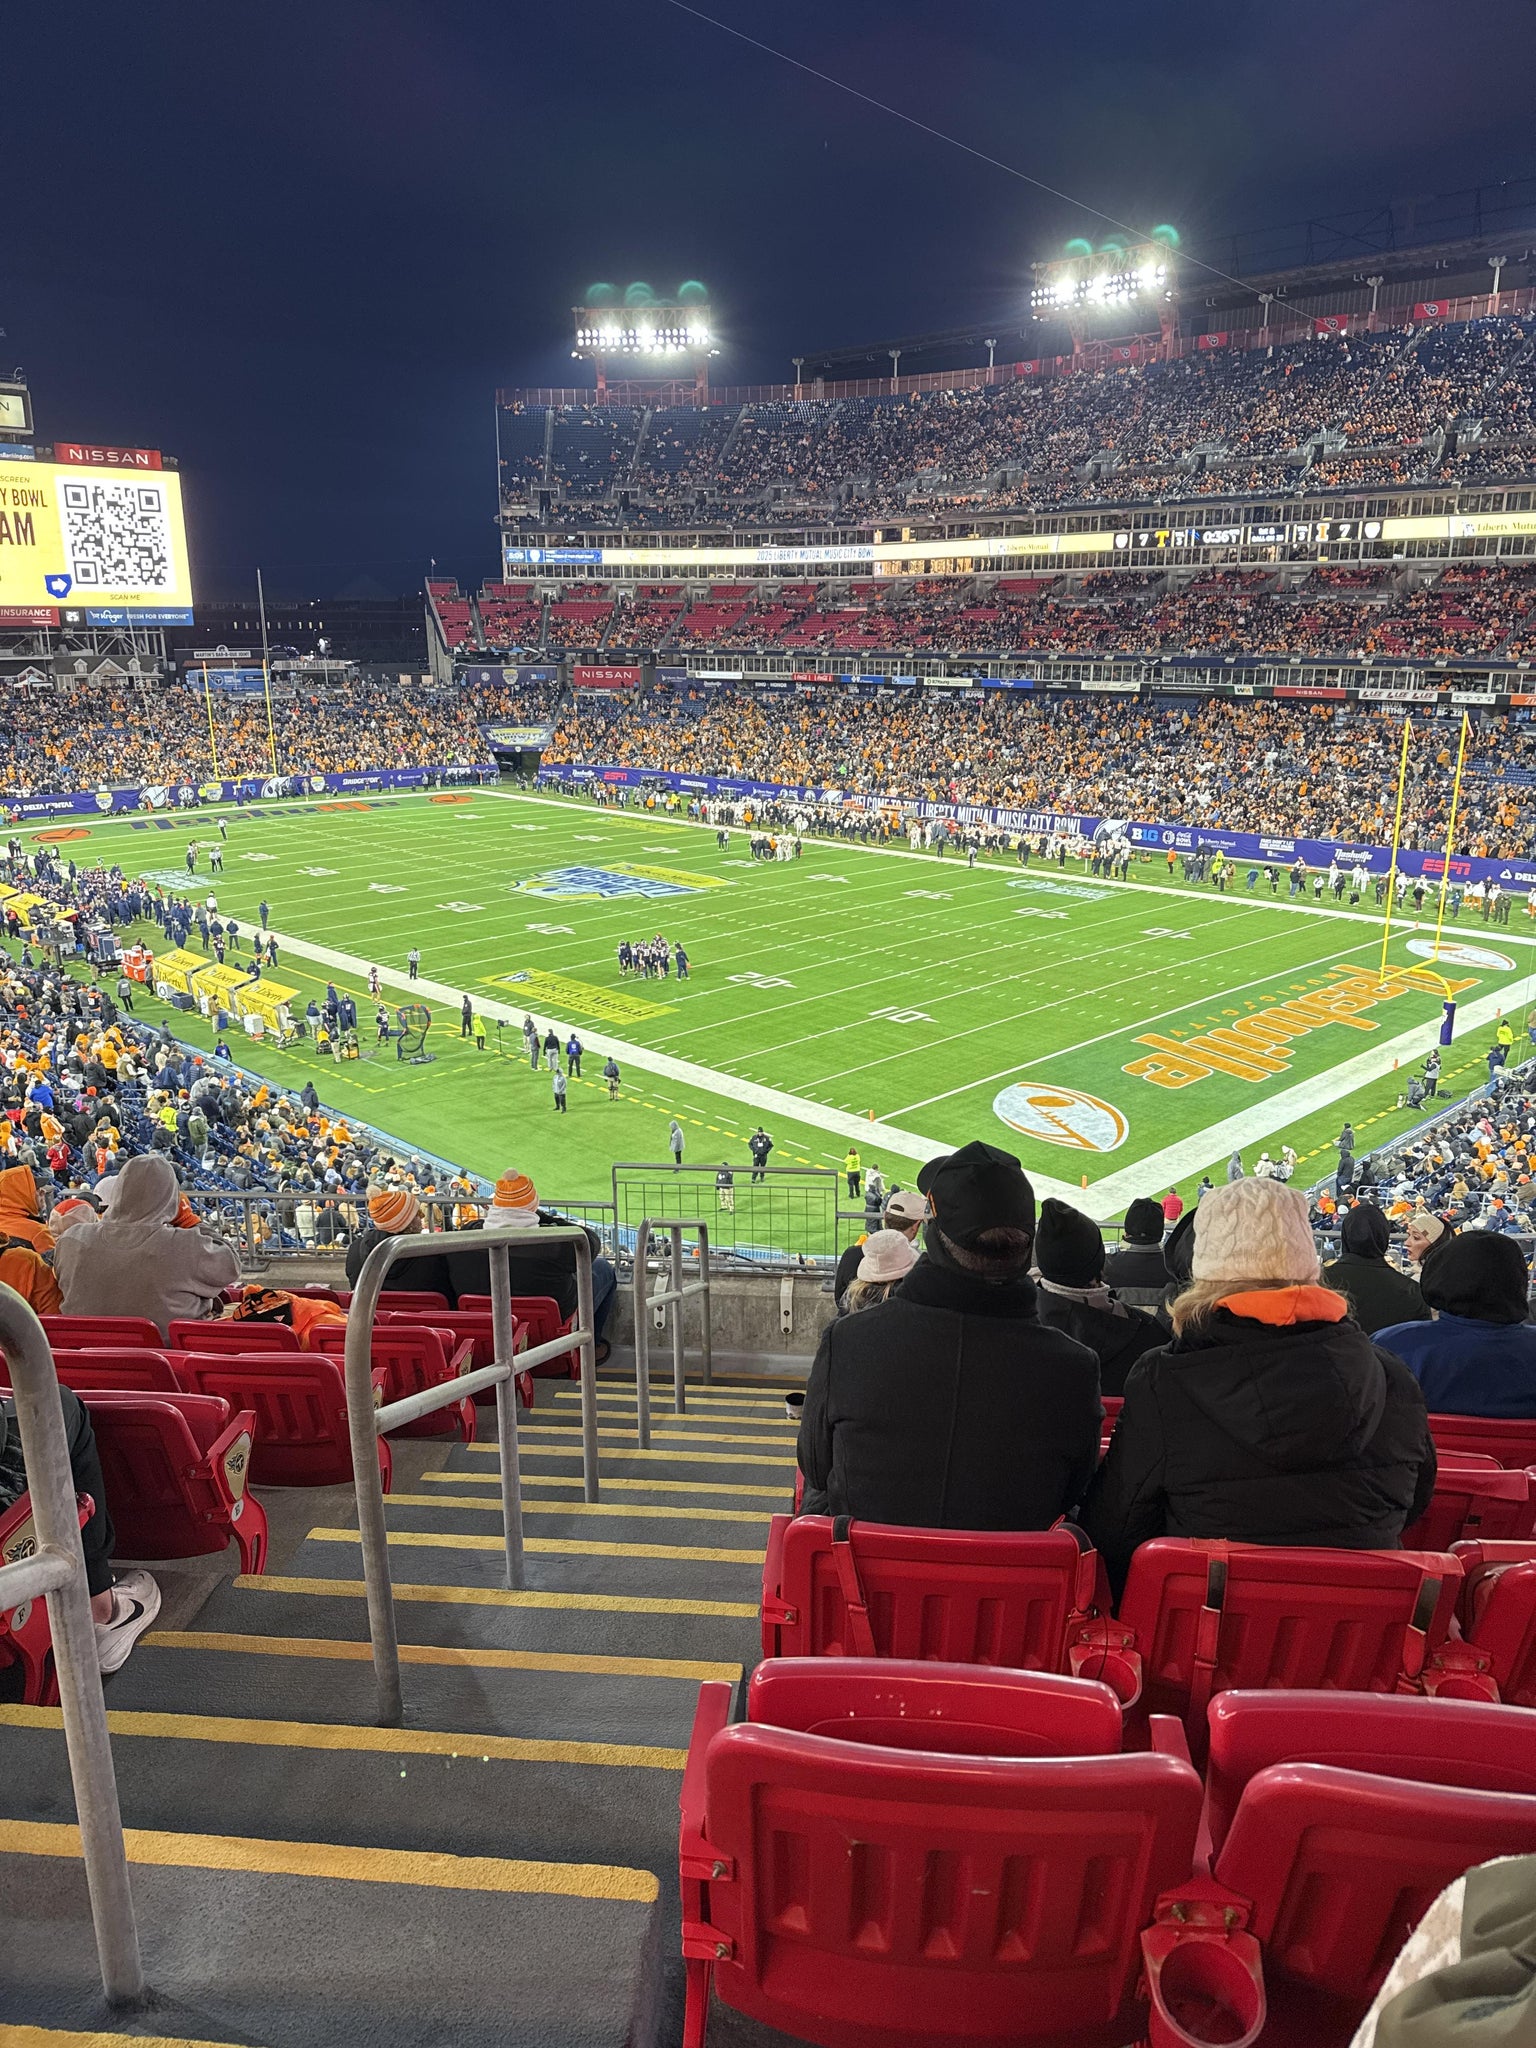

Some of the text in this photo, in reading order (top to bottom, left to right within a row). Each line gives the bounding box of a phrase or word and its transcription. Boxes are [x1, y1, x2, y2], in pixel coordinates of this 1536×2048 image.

[69, 448, 149, 465] NISSAN
[12, 488, 48, 507] BOWL
[1139, 533, 1149, 546] 7
[1154, 530, 1170, 547] T
[1202, 530, 1229, 544] 0:36
[1339, 523, 1351, 538] 7
[757, 547, 874, 561] 2025 LIBERTY MUTUAL MUSIC CITY BOWL
[110, 593, 126, 601] SCAN
[1, 609, 52, 617] INSURANCE
[101, 610, 123, 623] Kroger
[582, 670, 632, 679] NISSAN
[603, 771, 628, 781] ESPN
[22, 803, 45, 812] DELTA
[851, 794, 1081, 835] WELCOME TO THE LIBERTY MUTUAL MUSIC CITY BOWL
[1333, 848, 1374, 861] Nashville
[1421, 858, 1472, 876] ESPN
[725, 971, 792, 989] 20
[527, 978, 654, 1018] Liberty Mutual
[533, 992, 605, 1015] INSURANCE
[1169, 971, 1343, 1038] MUSIC CITY
[867, 1006, 932, 1024] 10
[17, 1607, 26, 1625] F
